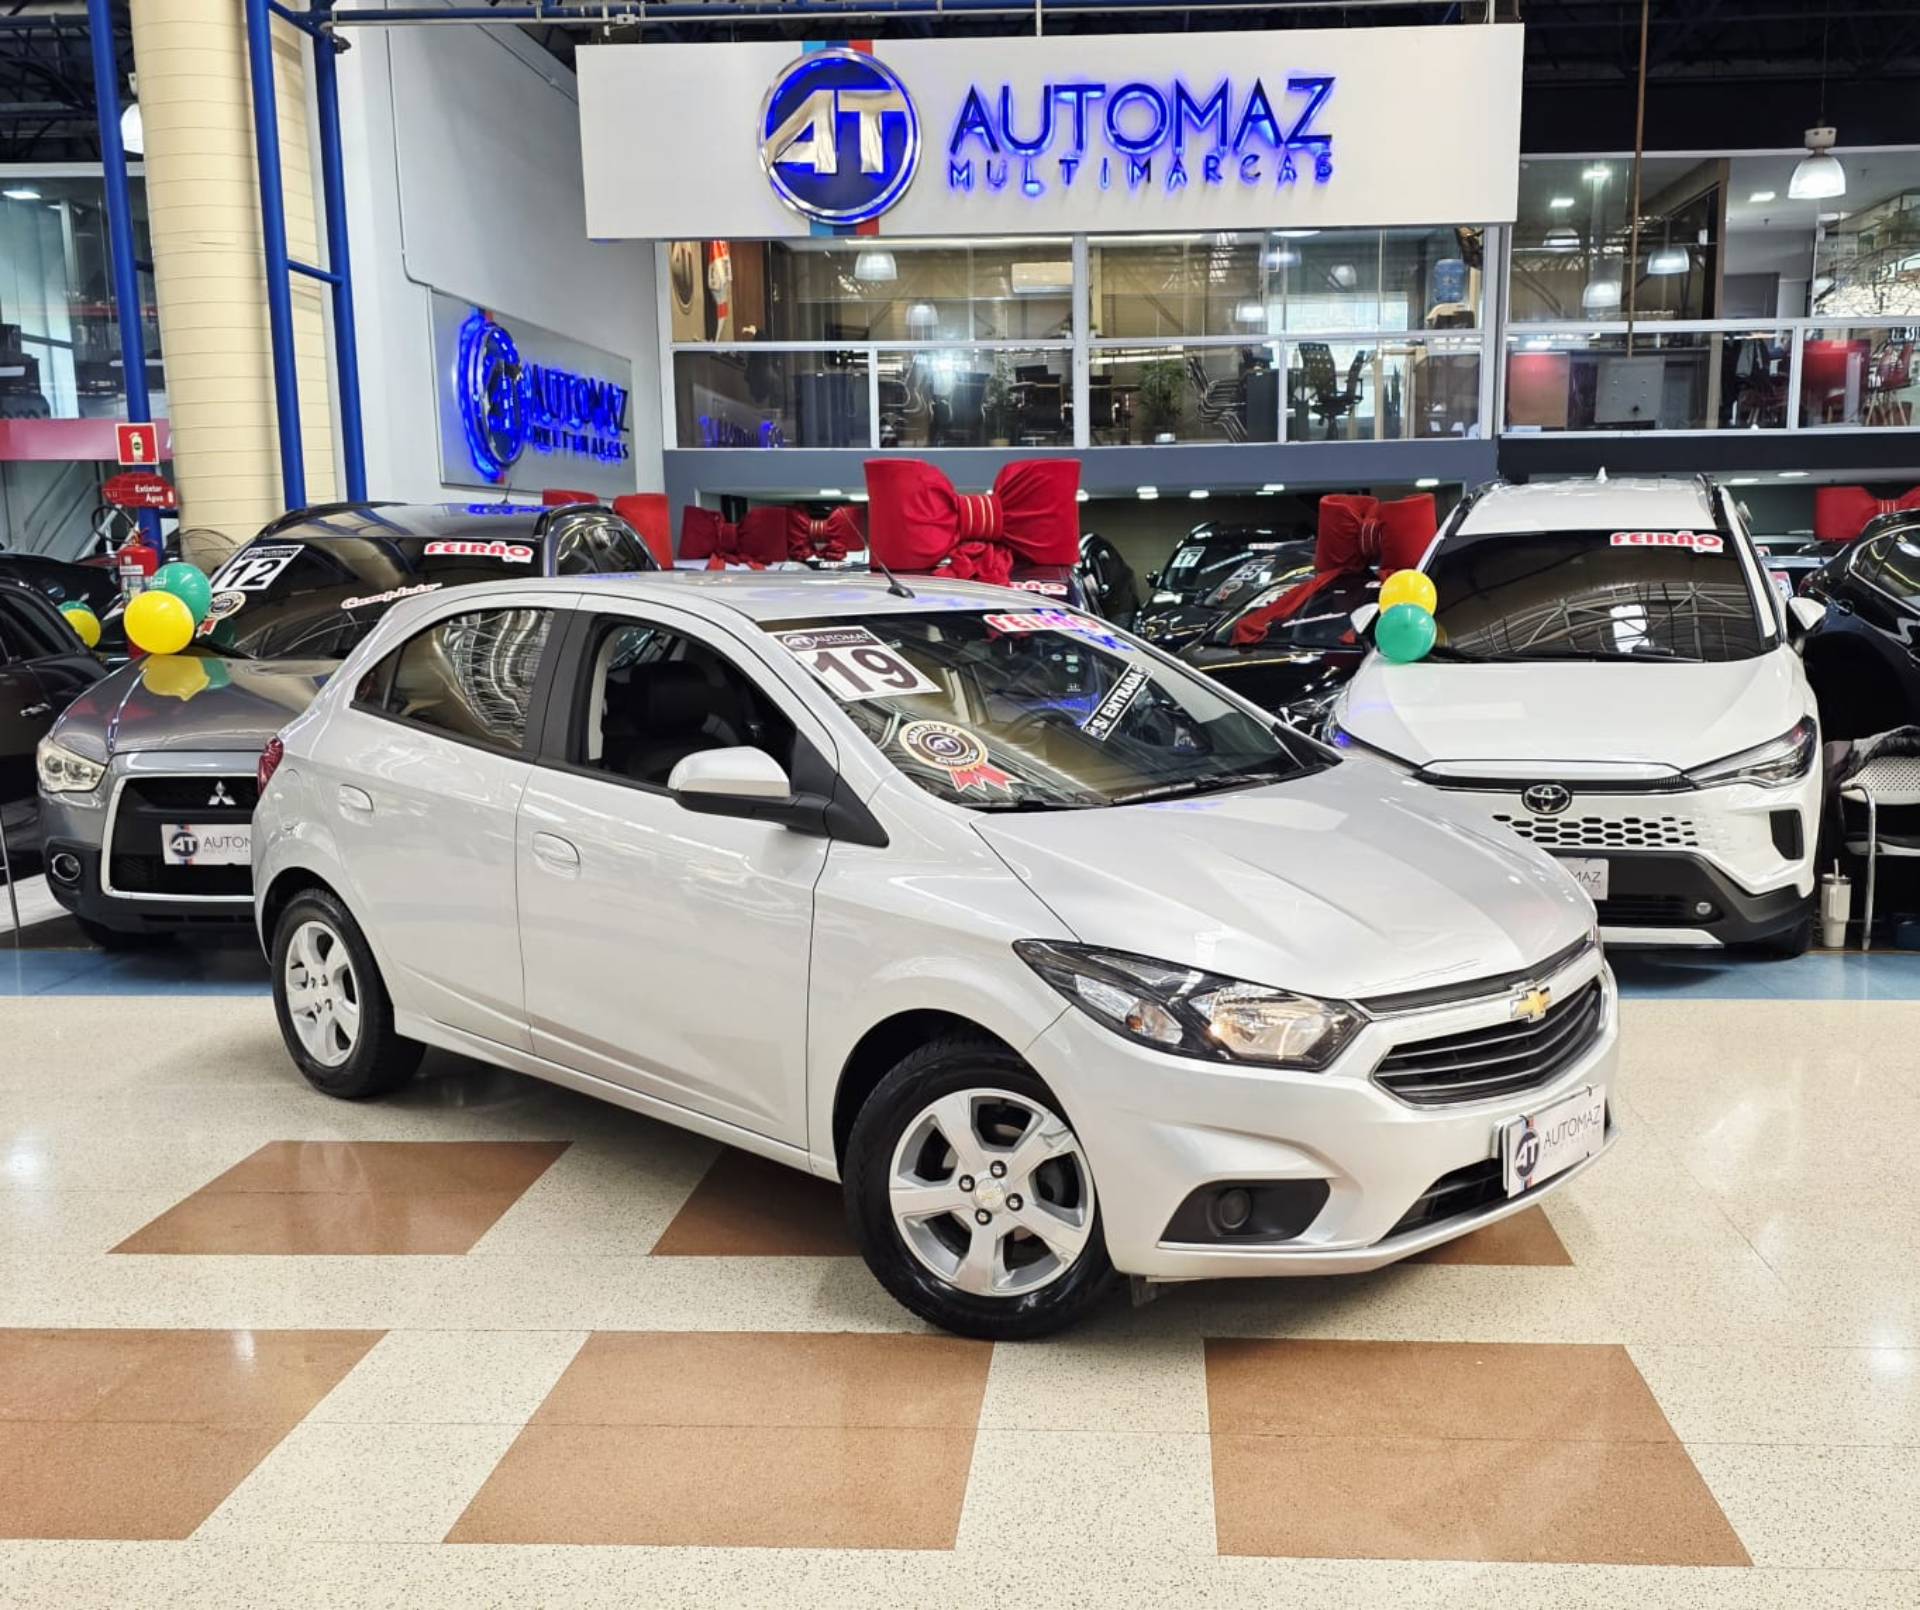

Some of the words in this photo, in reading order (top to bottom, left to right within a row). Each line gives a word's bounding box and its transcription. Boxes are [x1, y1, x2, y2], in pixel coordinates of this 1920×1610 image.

[764, 89, 907, 175] AT
[948, 77, 1336, 157] AUTOMAZ
[948, 152, 1334, 191] MULTIMARCAS
[529, 363, 630, 433] AUTOMAZ
[135, 484, 163, 493] Extintor
[427, 541, 532, 557] FEIRÃO
[1612, 532, 1722, 548] FEIRÃO
[224, 559, 282, 588] 12
[814, 633, 869, 643] AUTOMAZ
[813, 648, 918, 693] 19
[1100, 671, 1142, 719] ENTRADA
[172, 836, 198, 852] AT
[1516, 1138, 1539, 1168] AT
[1544, 1104, 1601, 1149] AUTOMAZ
